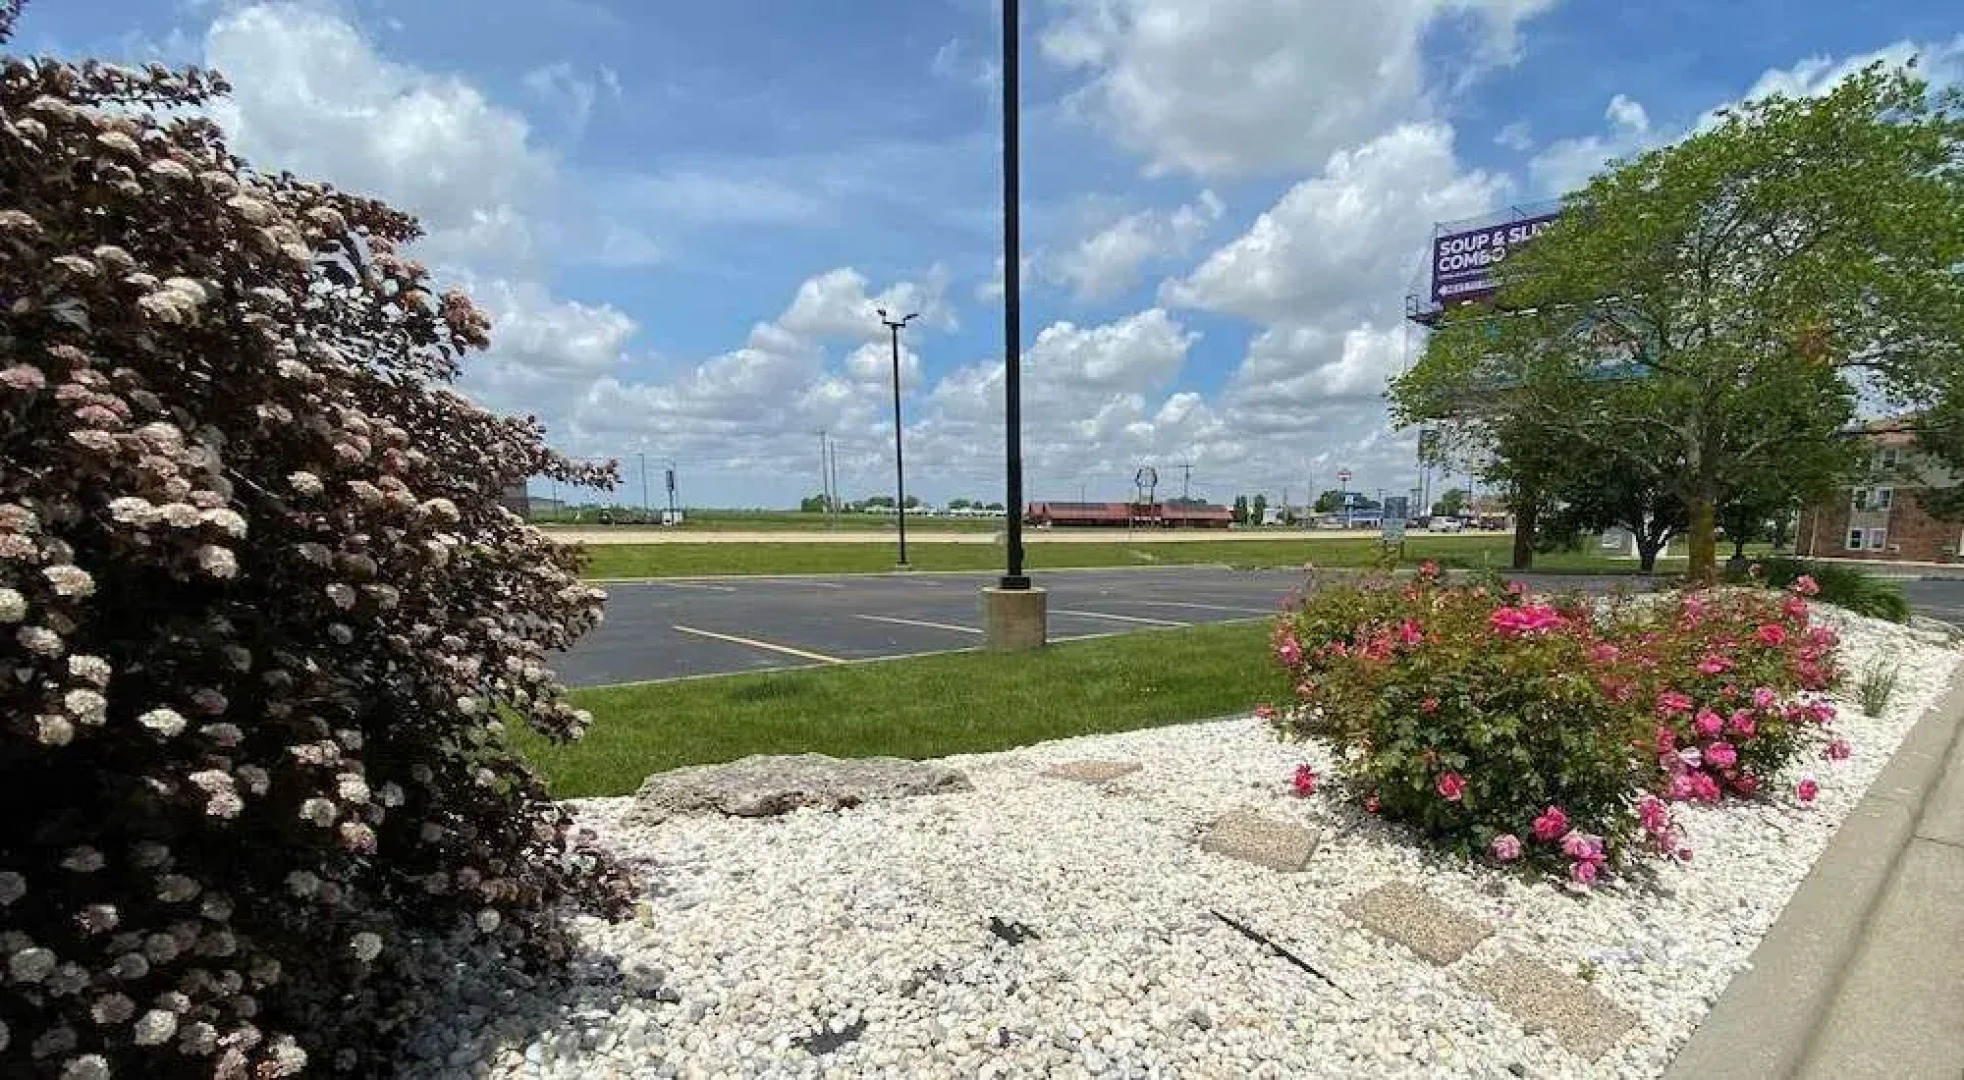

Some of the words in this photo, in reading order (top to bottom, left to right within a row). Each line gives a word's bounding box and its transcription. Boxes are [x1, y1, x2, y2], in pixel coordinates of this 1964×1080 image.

[1440, 234, 1489, 256] SOUP
[1492, 231, 1505, 246] &
[1439, 247, 1506, 271] COMBO
